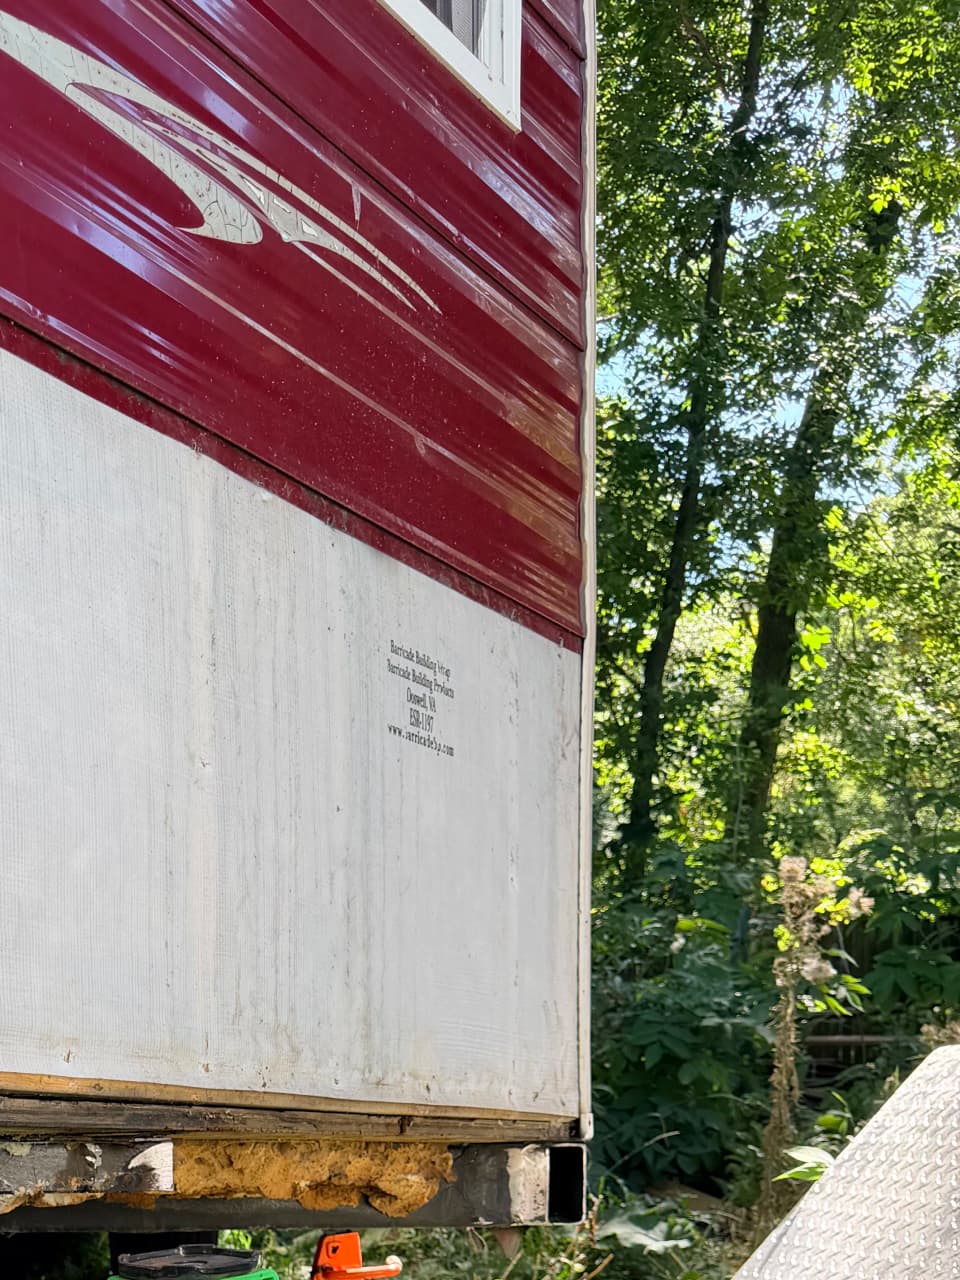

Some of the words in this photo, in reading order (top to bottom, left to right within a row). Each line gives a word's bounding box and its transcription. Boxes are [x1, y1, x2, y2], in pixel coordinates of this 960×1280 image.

[390, 639, 415, 662] Barricade
[415, 650, 437, 677] Building
[386, 658, 411, 680] Barricade
[411, 668, 433, 694] Building
[433, 678, 455, 699] Products
